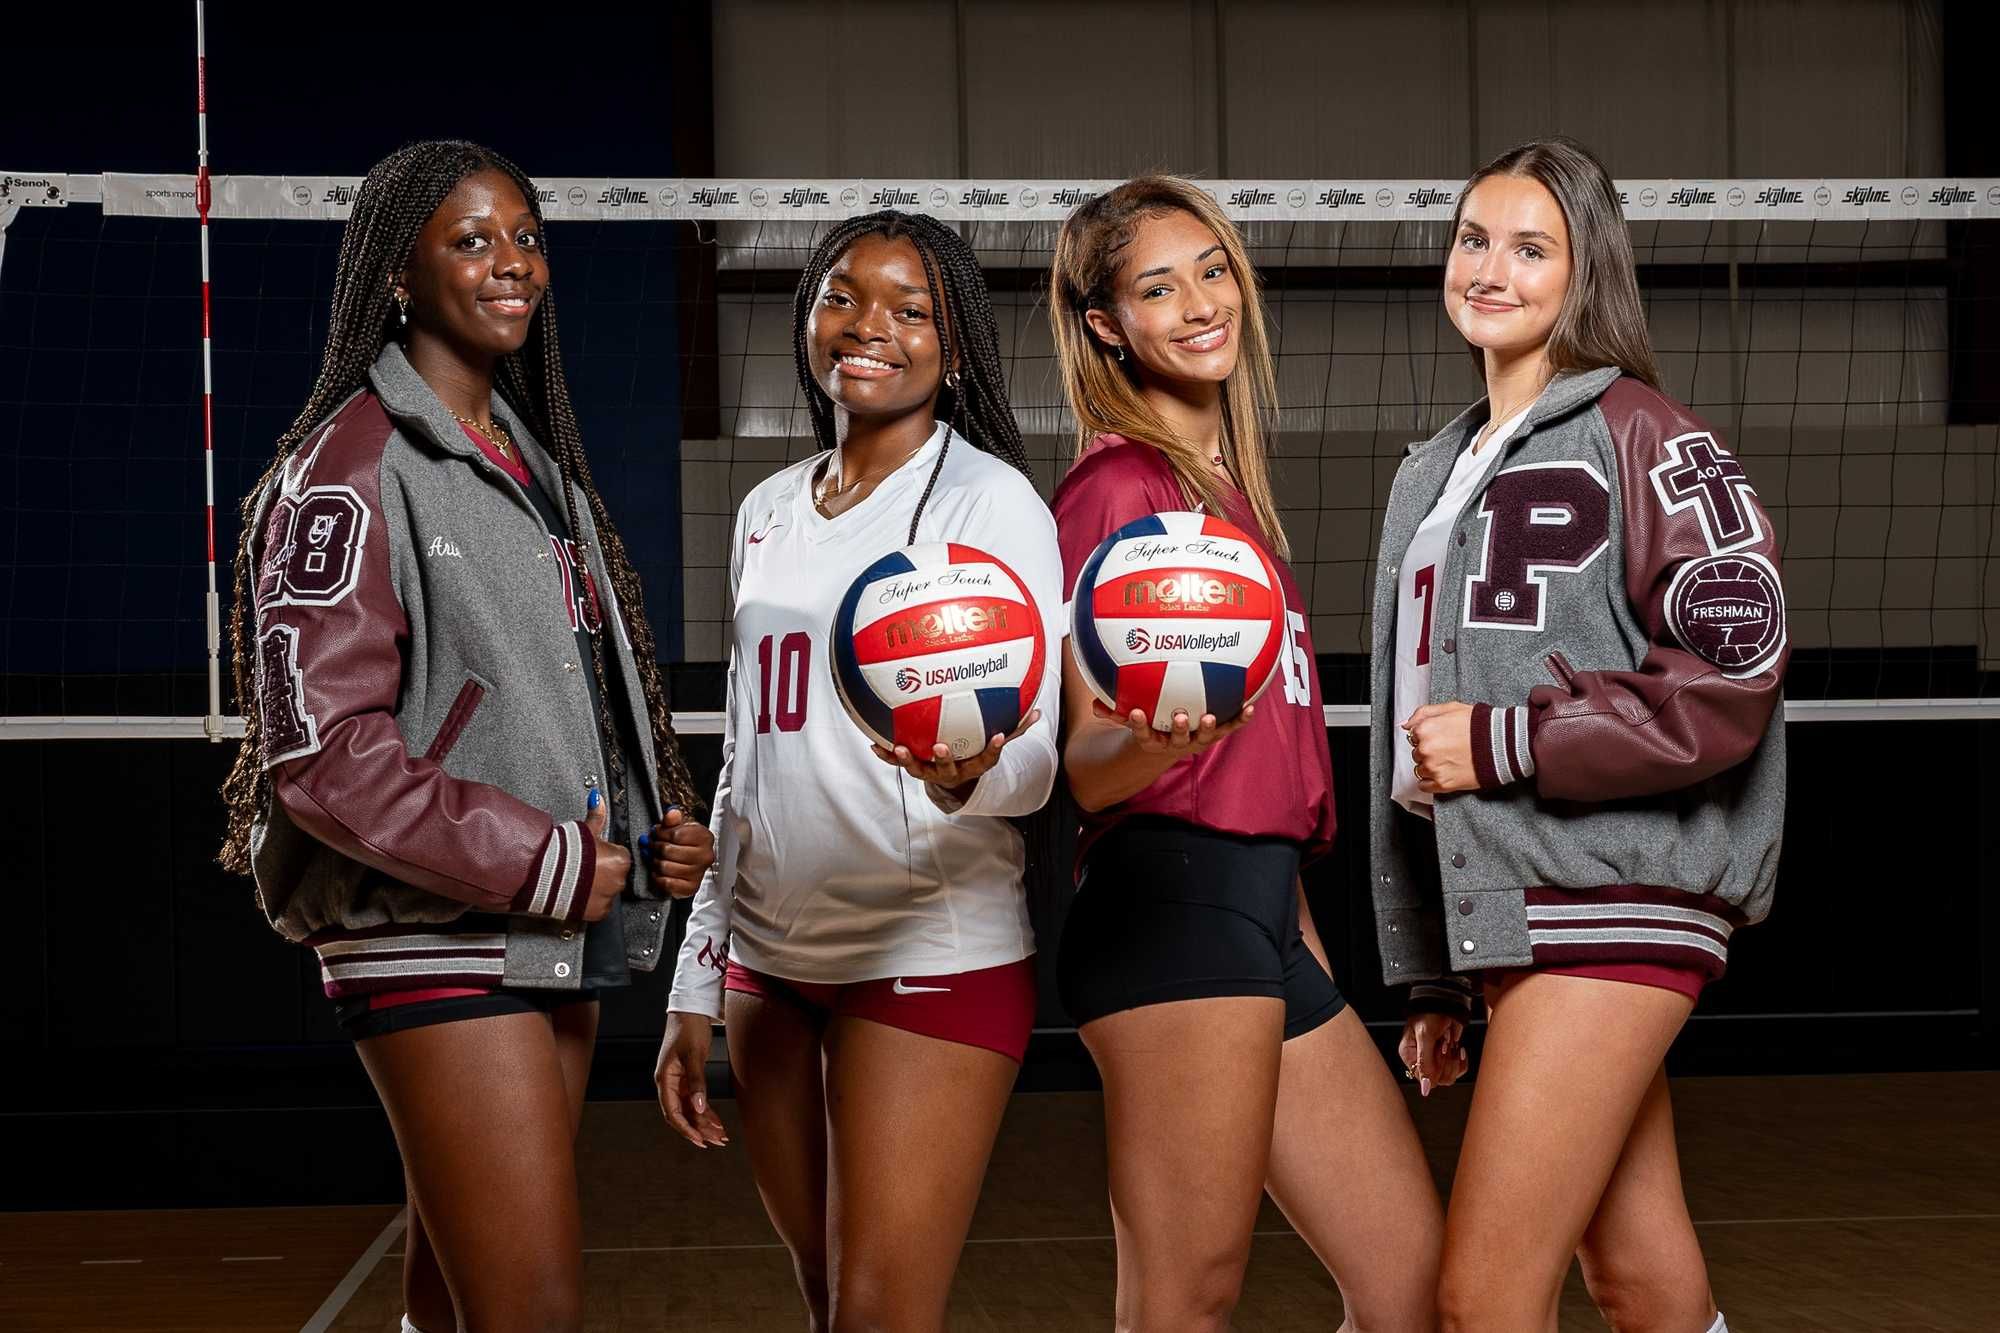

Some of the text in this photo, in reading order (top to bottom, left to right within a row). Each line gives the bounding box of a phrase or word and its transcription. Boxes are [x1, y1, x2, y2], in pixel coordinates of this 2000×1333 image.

[14, 179, 50, 187] Senoh
[145, 190, 171, 199] sports
[1125, 540, 1240, 563] Super Touch
[1462, 460, 1611, 632] P
[879, 569, 993, 604] Super Touch
[1123, 573, 1245, 608] molten
[886, 604, 1008, 648] molten
[1414, 563, 1436, 667] 7
[1692, 605, 1763, 619] FRESHMAN
[1721, 627, 1734, 645] 7
[1281, 610, 1311, 706] 15
[757, 631, 812, 735] 10
